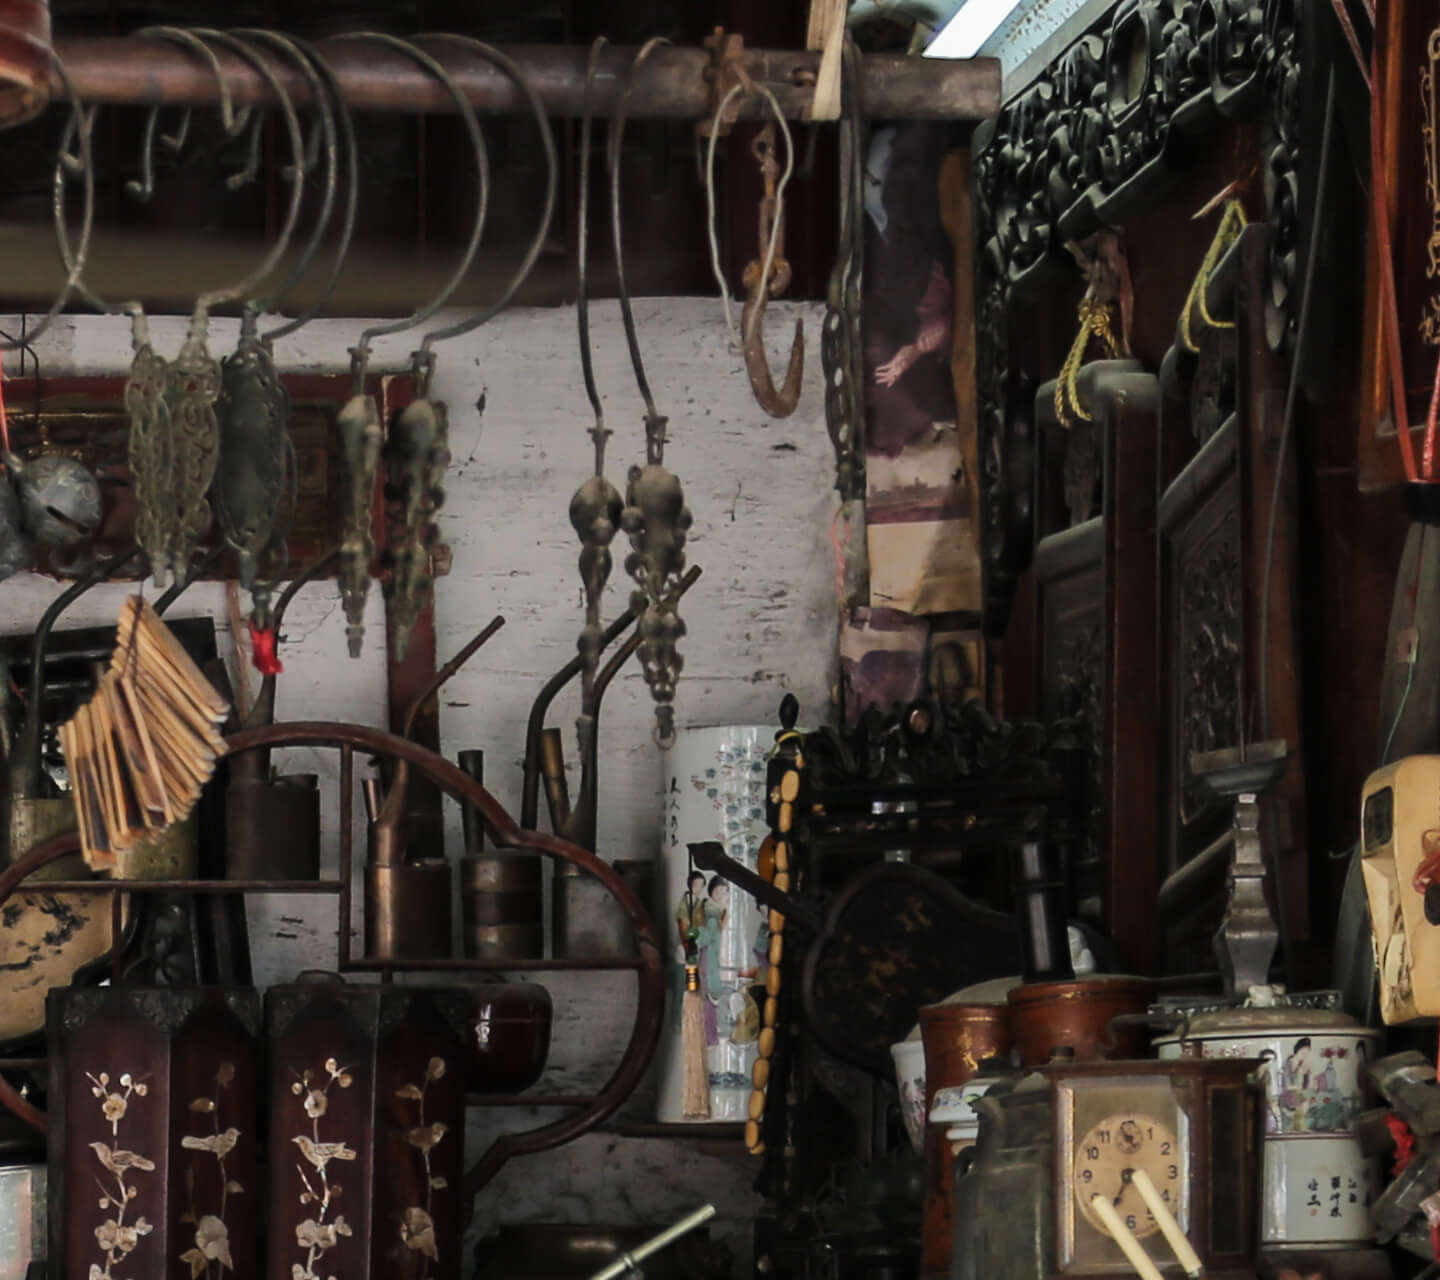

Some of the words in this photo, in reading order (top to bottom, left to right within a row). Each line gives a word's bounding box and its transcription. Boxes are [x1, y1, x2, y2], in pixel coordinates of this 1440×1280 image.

[1099, 1131, 1111, 1144] 11
[1087, 1146, 1099, 1160] 10
[1161, 1142, 1170, 1155] 2
[1082, 1169, 1092, 1183] 9
[1168, 1165, 1178, 1179] 3
[1161, 1189, 1170, 1202] 4
[1126, 1215, 1136, 1229] 6
